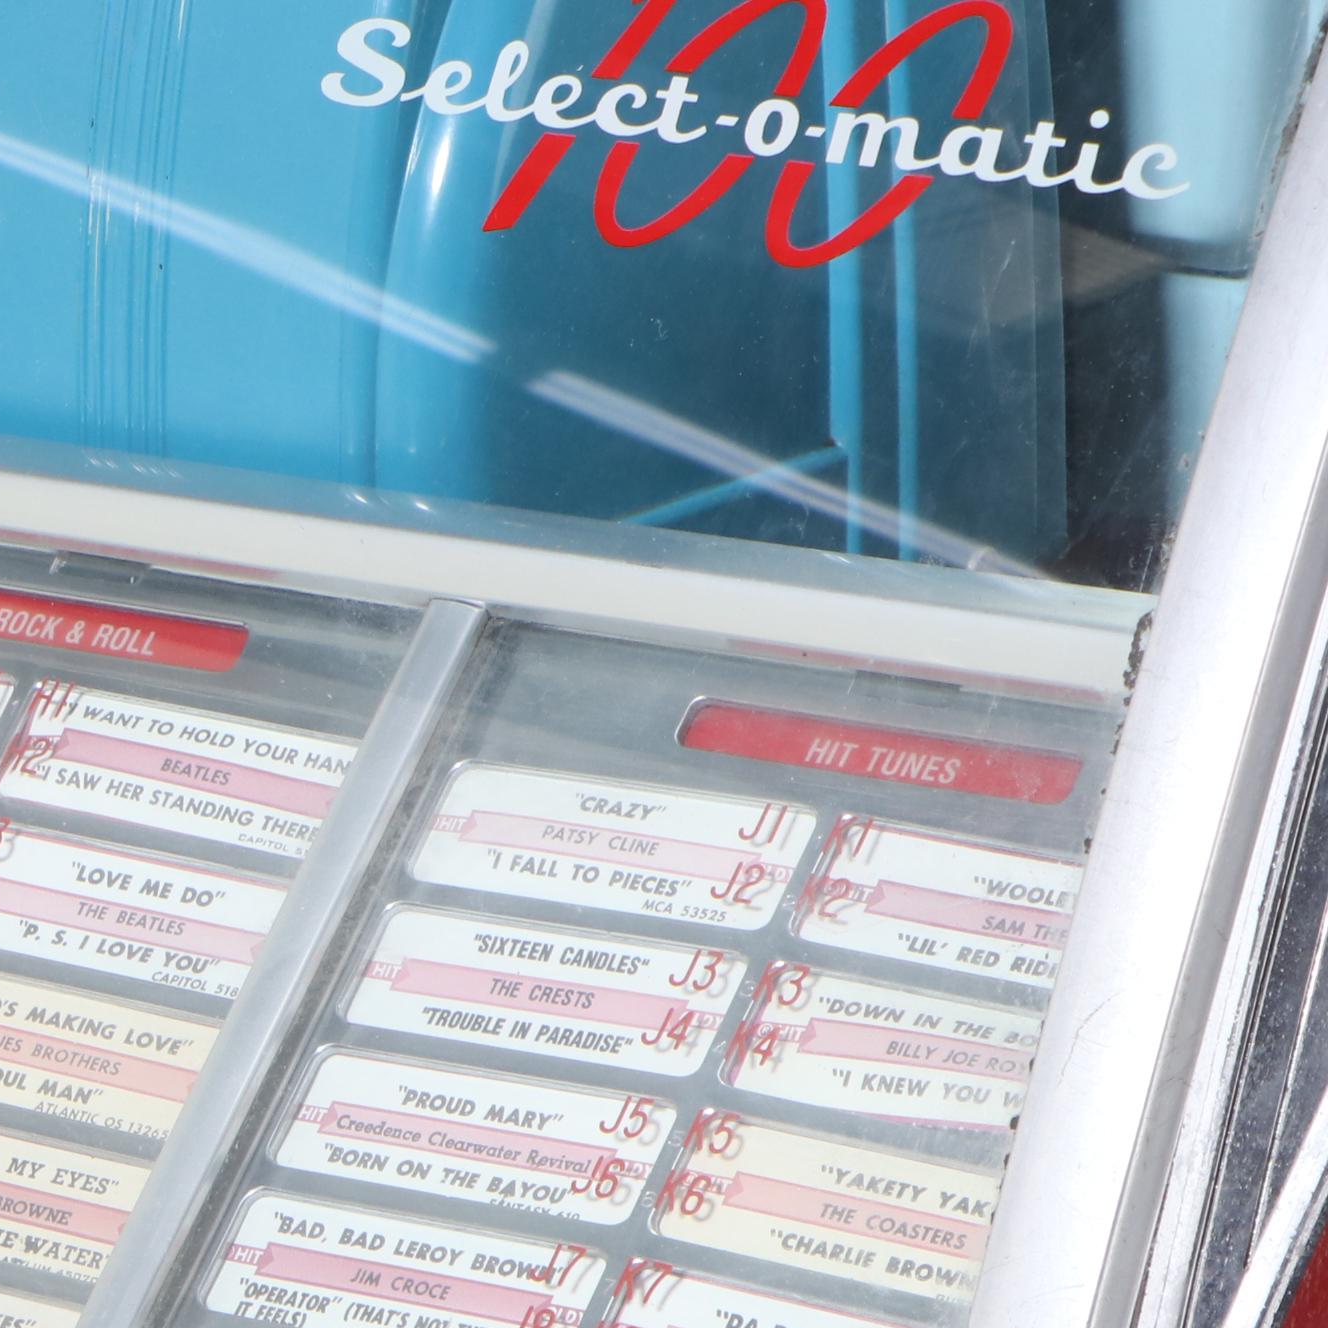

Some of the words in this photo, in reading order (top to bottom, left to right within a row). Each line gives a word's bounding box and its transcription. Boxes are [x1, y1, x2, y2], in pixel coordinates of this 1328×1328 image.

[321, 17, 1191, 199] Select-o-matic
[91, 624, 155, 655] ROLL
[805, 738, 857, 767] HIT
[867, 747, 961, 784] TUNES
